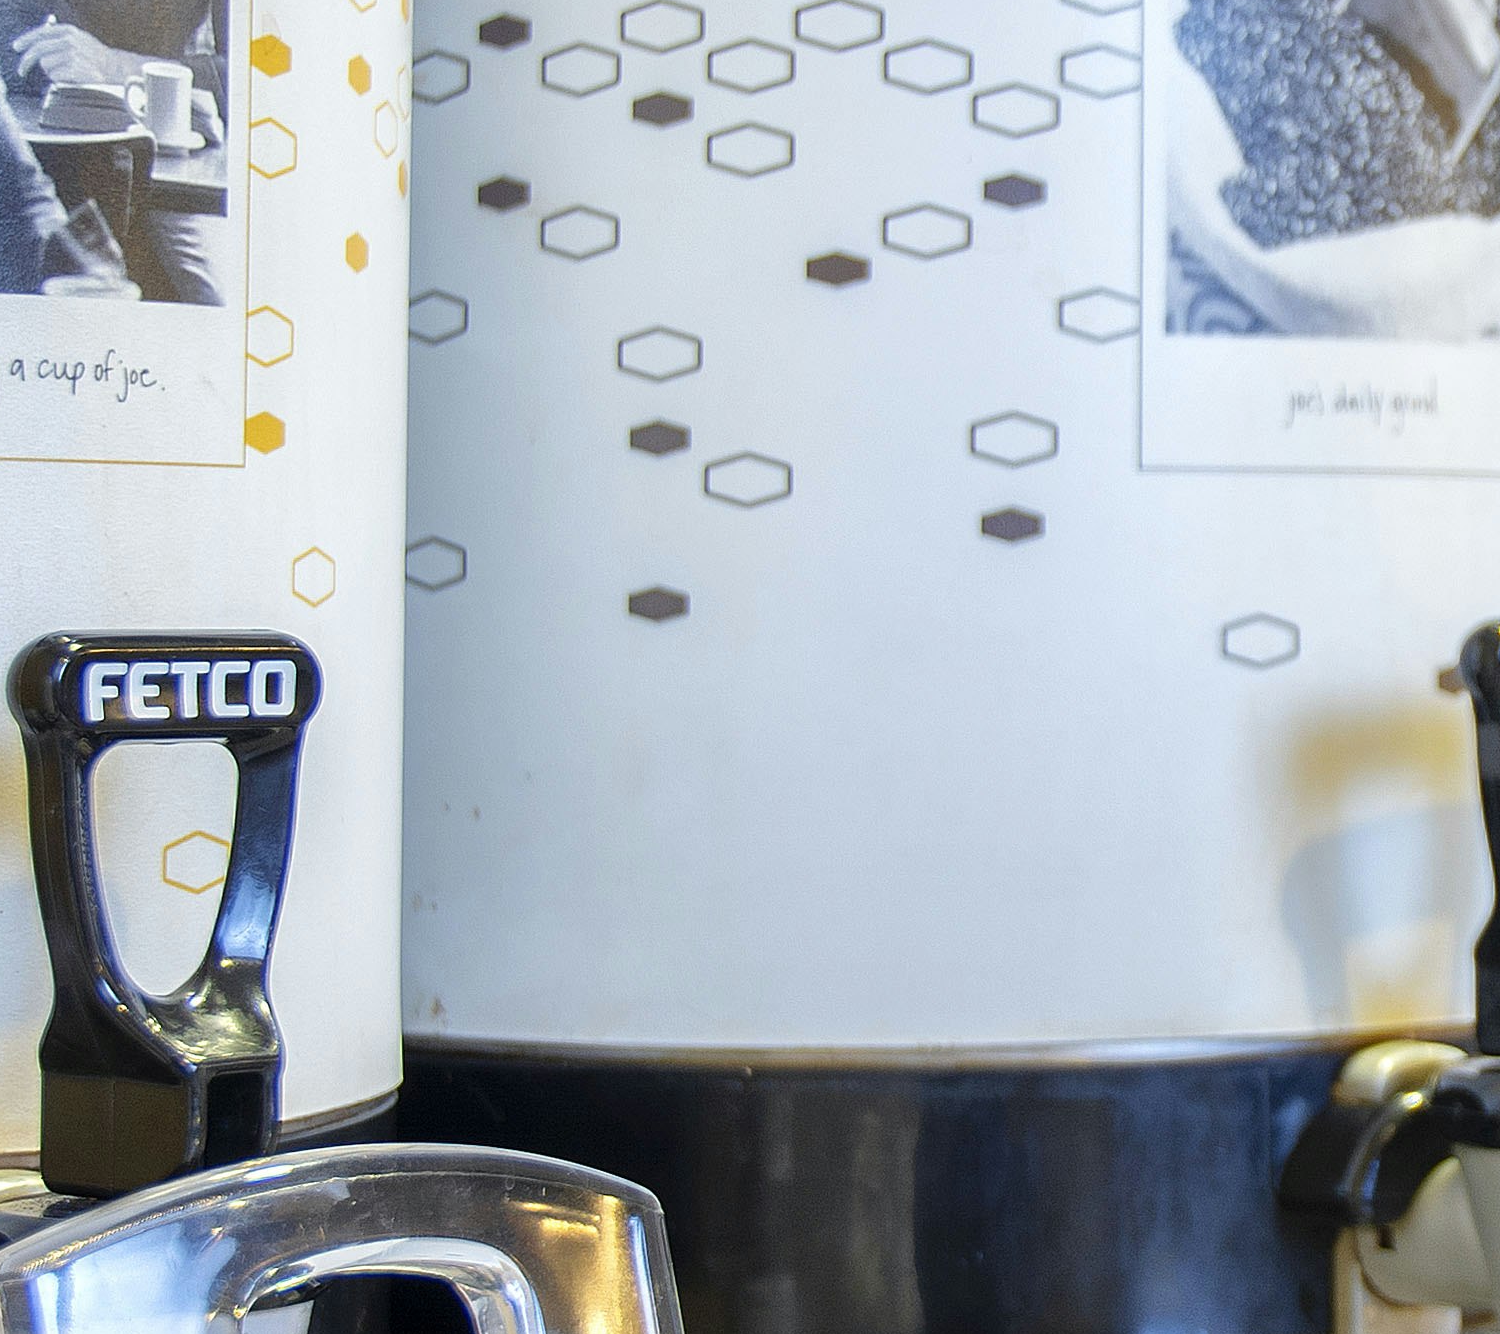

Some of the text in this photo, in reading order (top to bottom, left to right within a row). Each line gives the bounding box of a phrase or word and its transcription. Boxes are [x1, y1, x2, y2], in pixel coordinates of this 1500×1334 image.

[10, 358, 26, 382] a
[37, 359, 86, 395] cup
[94, 348, 117, 382] of
[86, 658, 297, 723] FETCO
